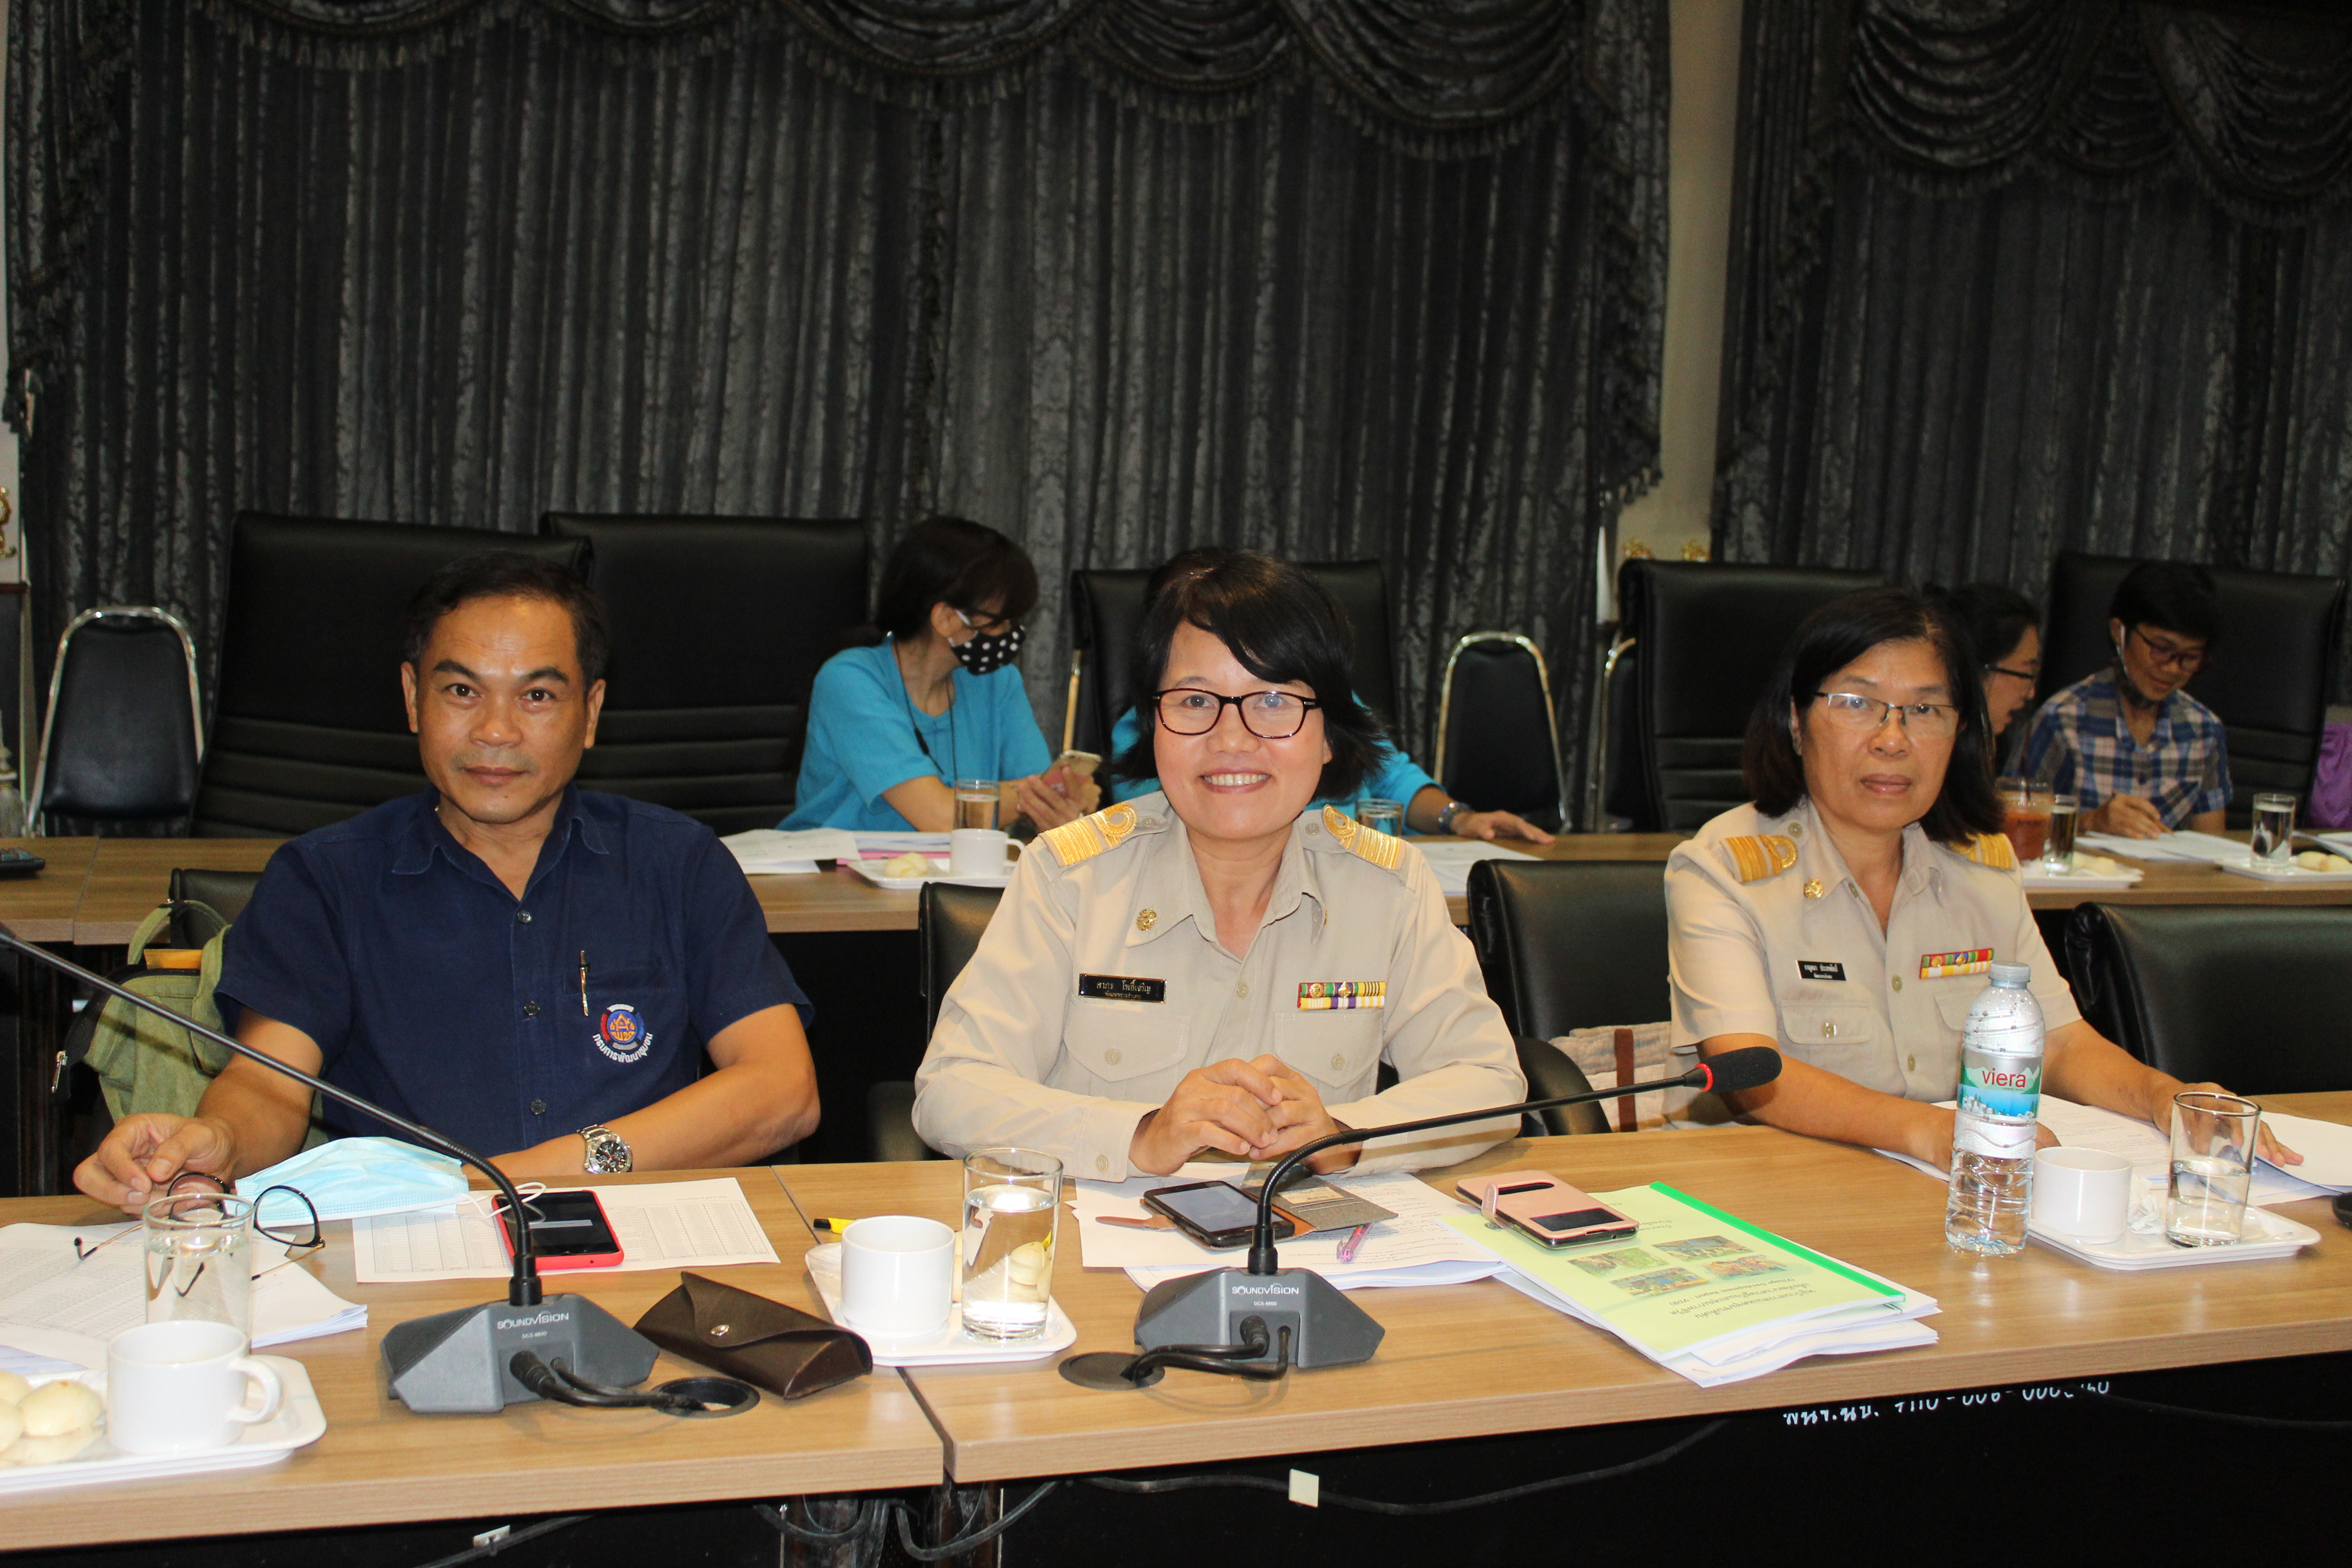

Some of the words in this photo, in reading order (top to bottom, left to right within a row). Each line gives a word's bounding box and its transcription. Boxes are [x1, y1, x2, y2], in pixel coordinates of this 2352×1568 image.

[592, 1032, 654, 1063] กรมการพัฒนาชุมชน
[1982, 1068, 2026, 1087] viera
[1232, 1283, 1299, 1295] SOUNDVISION
[497, 1311, 569, 1330] SOUNDVISION
